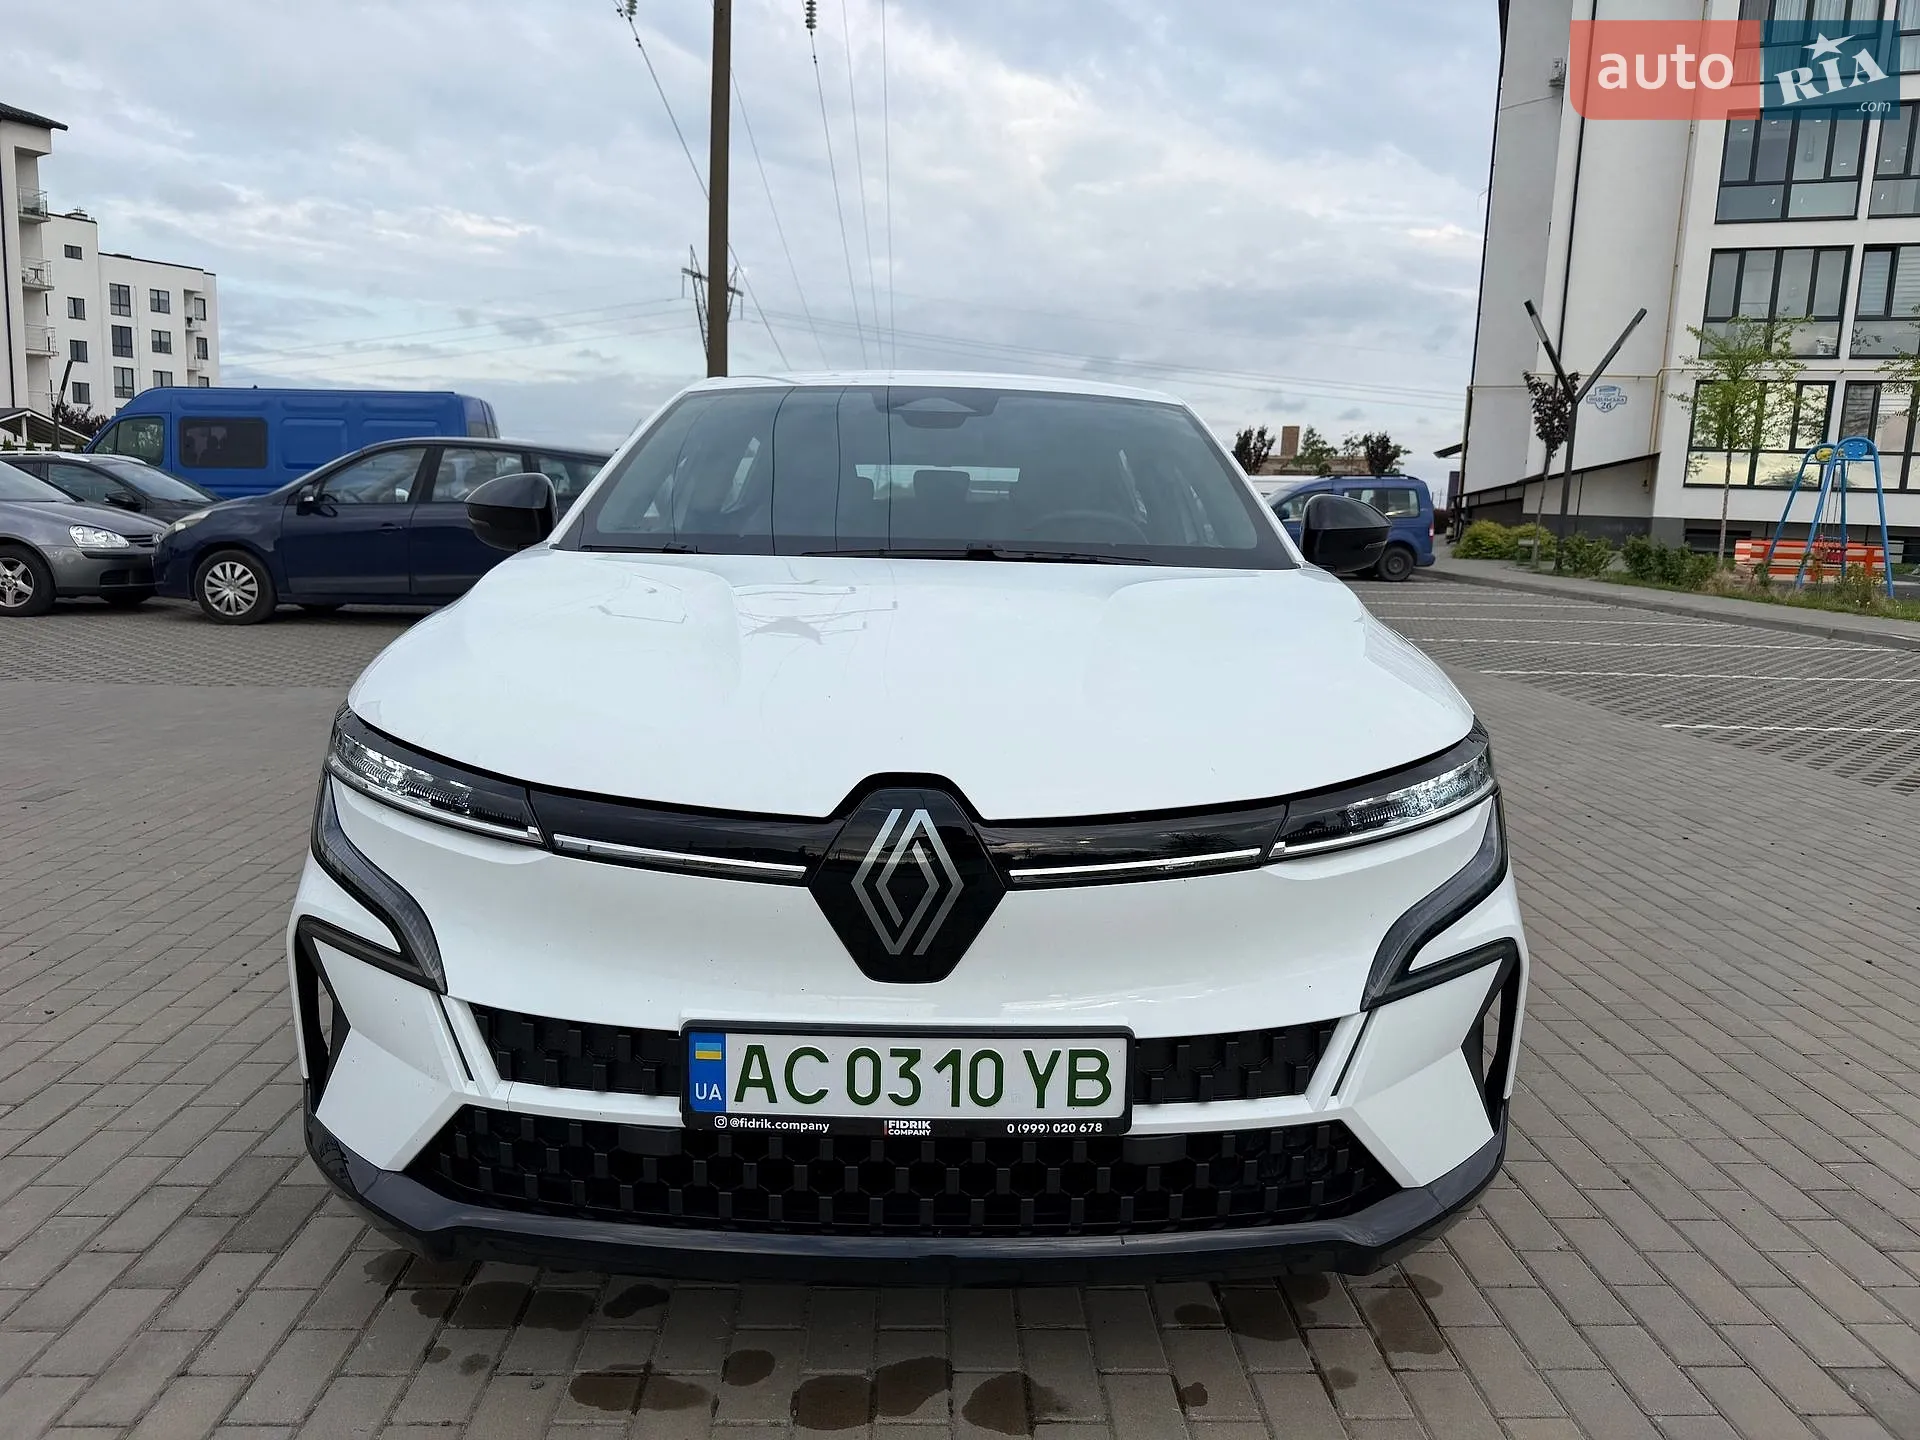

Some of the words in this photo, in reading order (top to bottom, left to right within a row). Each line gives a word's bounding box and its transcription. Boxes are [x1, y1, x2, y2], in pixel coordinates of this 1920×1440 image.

[734, 1044, 830, 1105] AC
[846, 1047, 1004, 1107] 0310
[1022, 1049, 1112, 1109] YB
[695, 1083, 722, 1101] UA
[729, 1118, 830, 1133] @fidrik.company
[888, 1120, 931, 1130] FIDRIK
[1007, 1124, 1015, 1133] 0
[1017, 1123, 1050, 1134] (999)
[1053, 1124, 1077, 1133] 020
[1079, 1123, 1103, 1133] 678
